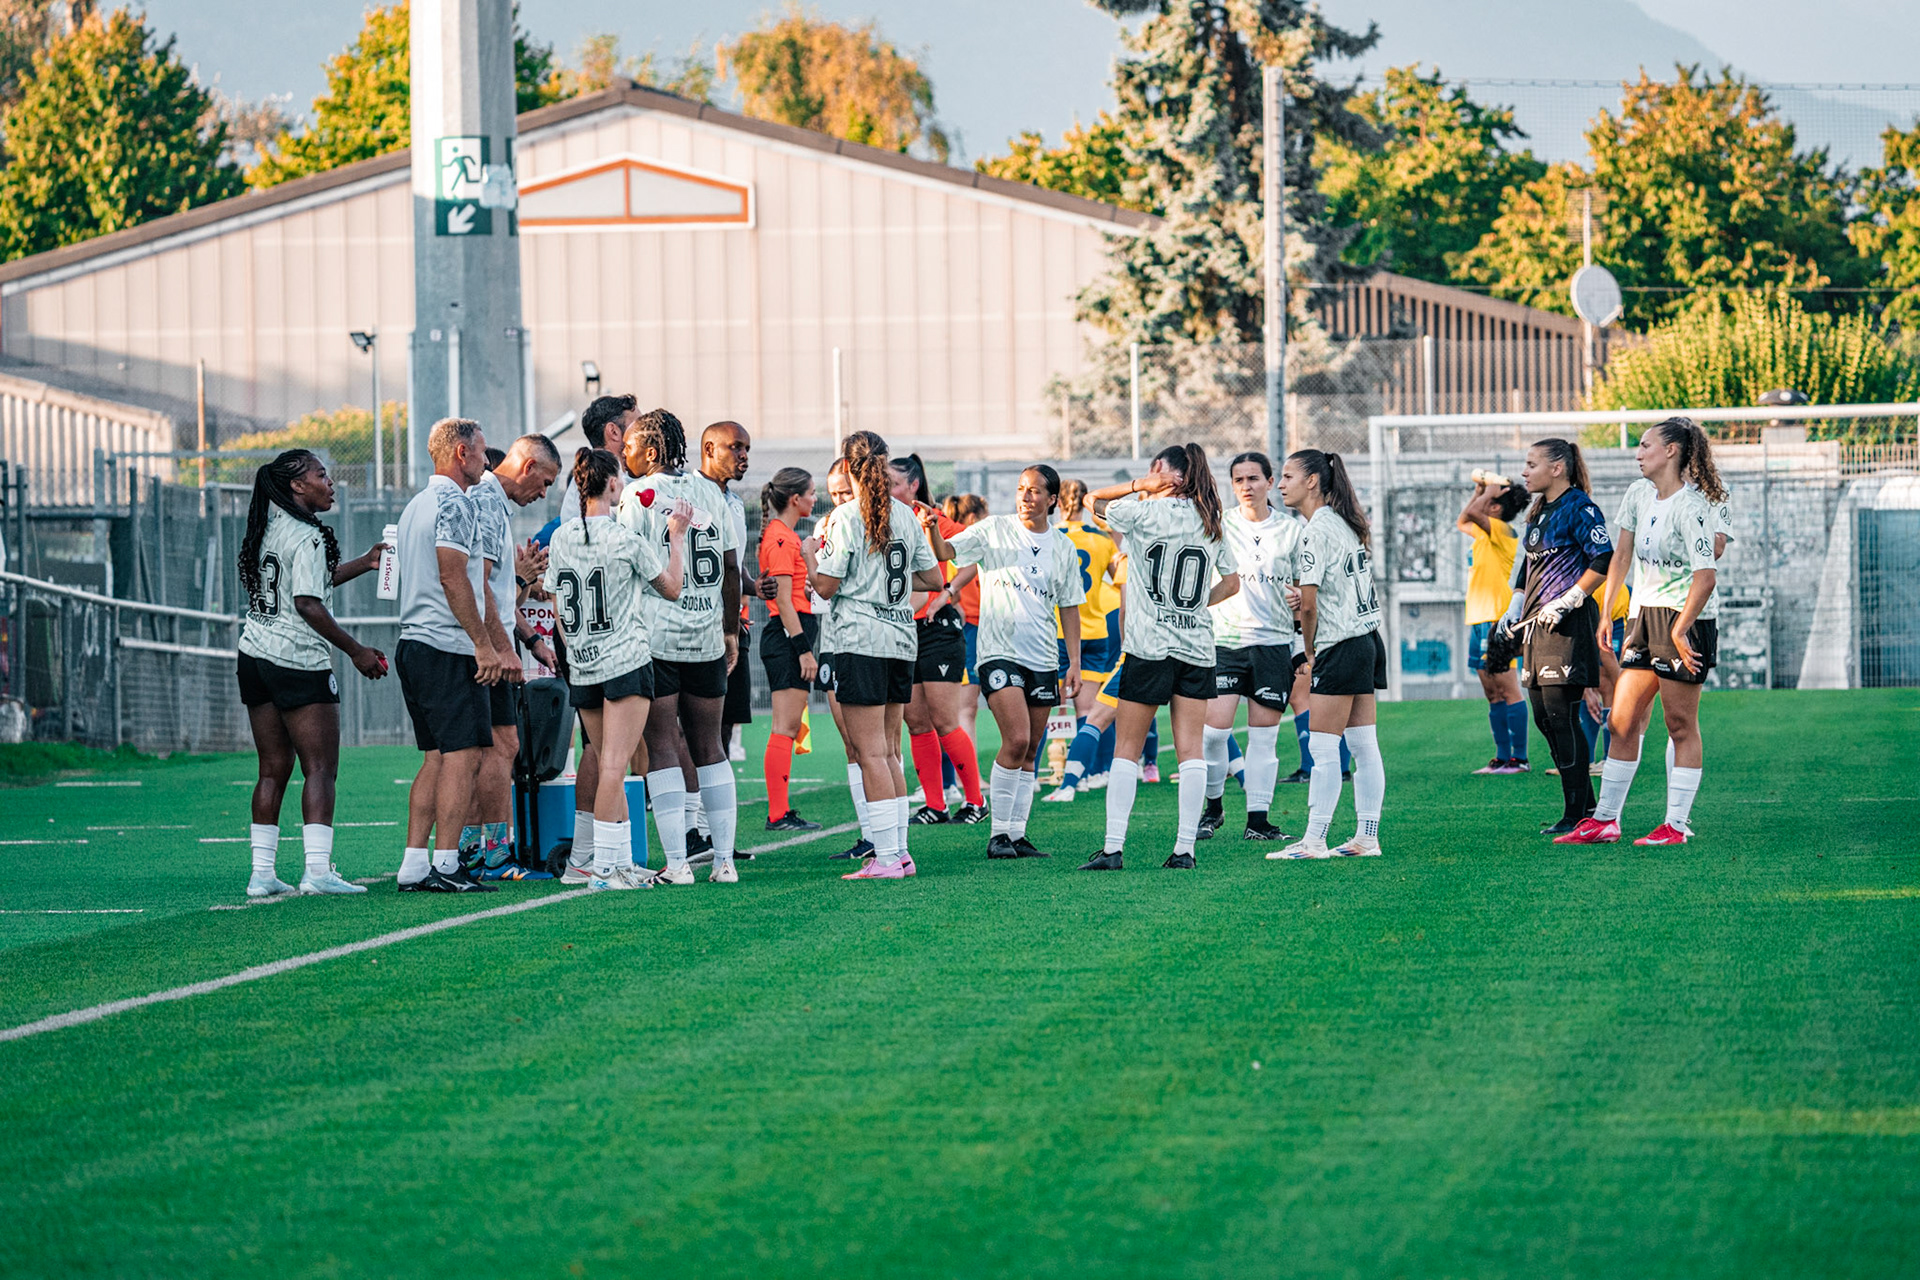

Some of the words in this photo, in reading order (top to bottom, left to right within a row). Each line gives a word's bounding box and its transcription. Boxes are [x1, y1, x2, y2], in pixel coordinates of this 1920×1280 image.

[256, 550, 283, 618] 3
[383, 556, 392, 592] SPONSER
[556, 566, 614, 637] 31
[883, 539, 909, 608] 8
[1144, 541, 1210, 612] 10
